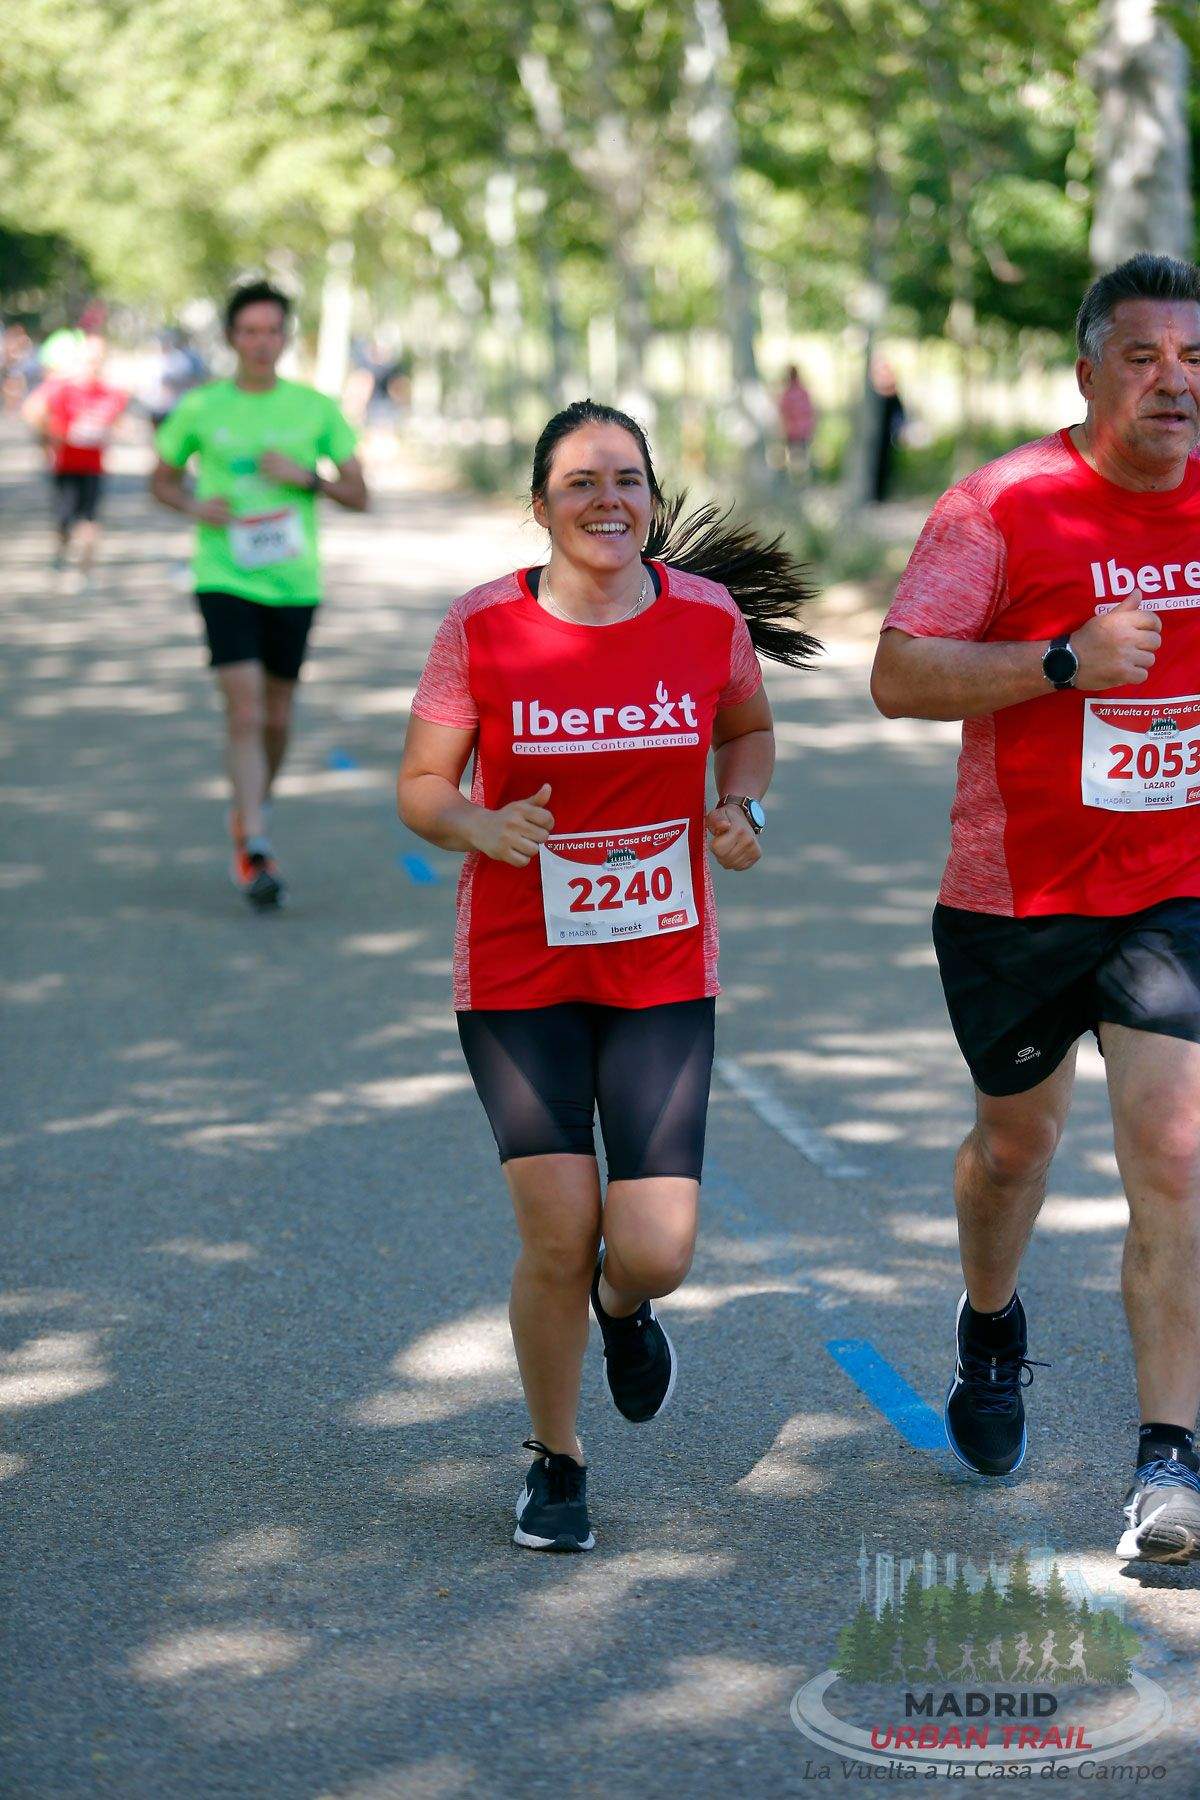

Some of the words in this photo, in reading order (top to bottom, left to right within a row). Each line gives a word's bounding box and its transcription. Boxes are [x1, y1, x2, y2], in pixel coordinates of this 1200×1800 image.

[512, 688, 698, 736] Iberext
[1112, 708, 1142, 716] Vuelta
[1151, 708, 1160, 716] la
[1162, 707, 1182, 715] Casa
[1182, 704, 1192, 713] de
[515, 742, 585, 753] Protección
[591, 740, 636, 751] Contra
[642, 735, 698, 747] Incendios
[1107, 739, 1200, 780] 2053
[1144, 780, 1176, 790] LAZARO
[1144, 794, 1174, 803] Iberext
[566, 841, 596, 850] Vuelta
[605, 840, 615, 848] la
[618, 837, 640, 846] Casa
[641, 834, 652, 843] de
[653, 829, 680, 840] Campo
[567, 866, 673, 913] 2240
[568, 929, 598, 937] MADRID
[611, 923, 642, 933] Iberext
